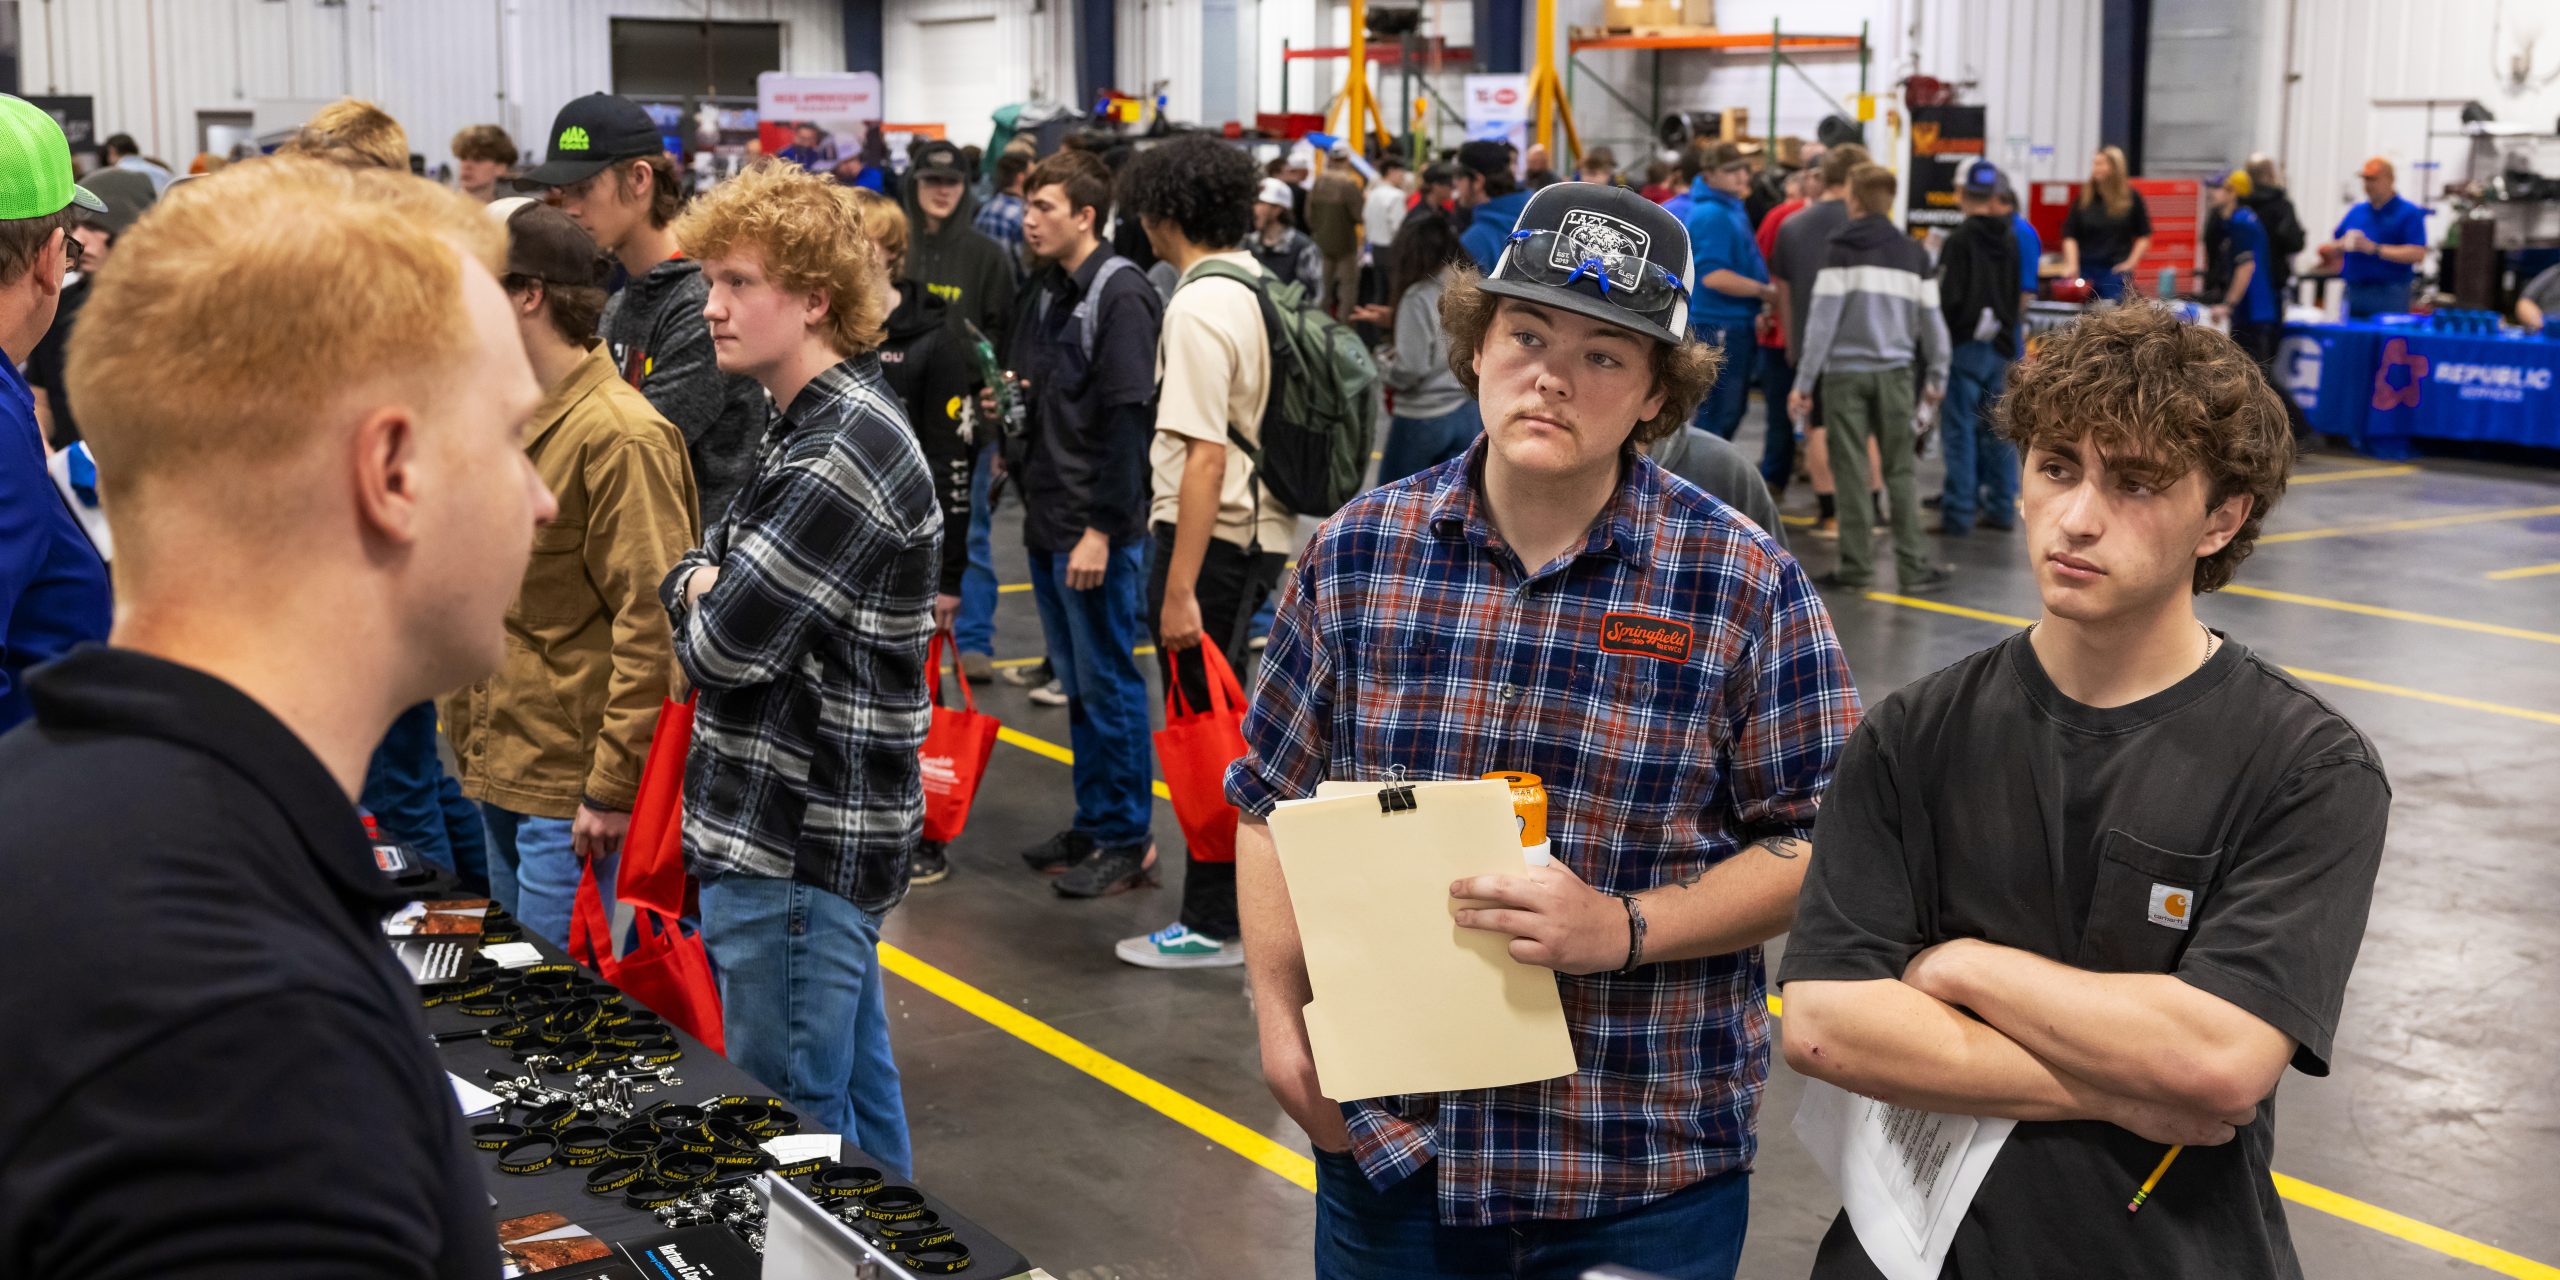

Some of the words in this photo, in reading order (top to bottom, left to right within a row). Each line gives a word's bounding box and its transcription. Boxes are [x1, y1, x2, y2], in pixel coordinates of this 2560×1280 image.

[559, 126, 589, 143] MAC
[559, 141, 590, 151] TOOLS
[1567, 213, 1608, 227] LAZY
[2433, 361, 2553, 391] REPUBLIC
[1606, 621, 1687, 647] Springfield
[2153, 914, 2183, 924] carhartt
[568, 1147, 595, 1156] MONEY
[690, 1145, 713, 1153] DIRTY
[521, 1162, 545, 1173] DIRTY
[788, 1166, 813, 1176] DIRTY
[610, 1174, 638, 1190] MONEY
[838, 1188, 861, 1196] DIRTY
[871, 1211, 894, 1221] DIRTY
[895, 1211, 921, 1221] HANDS
